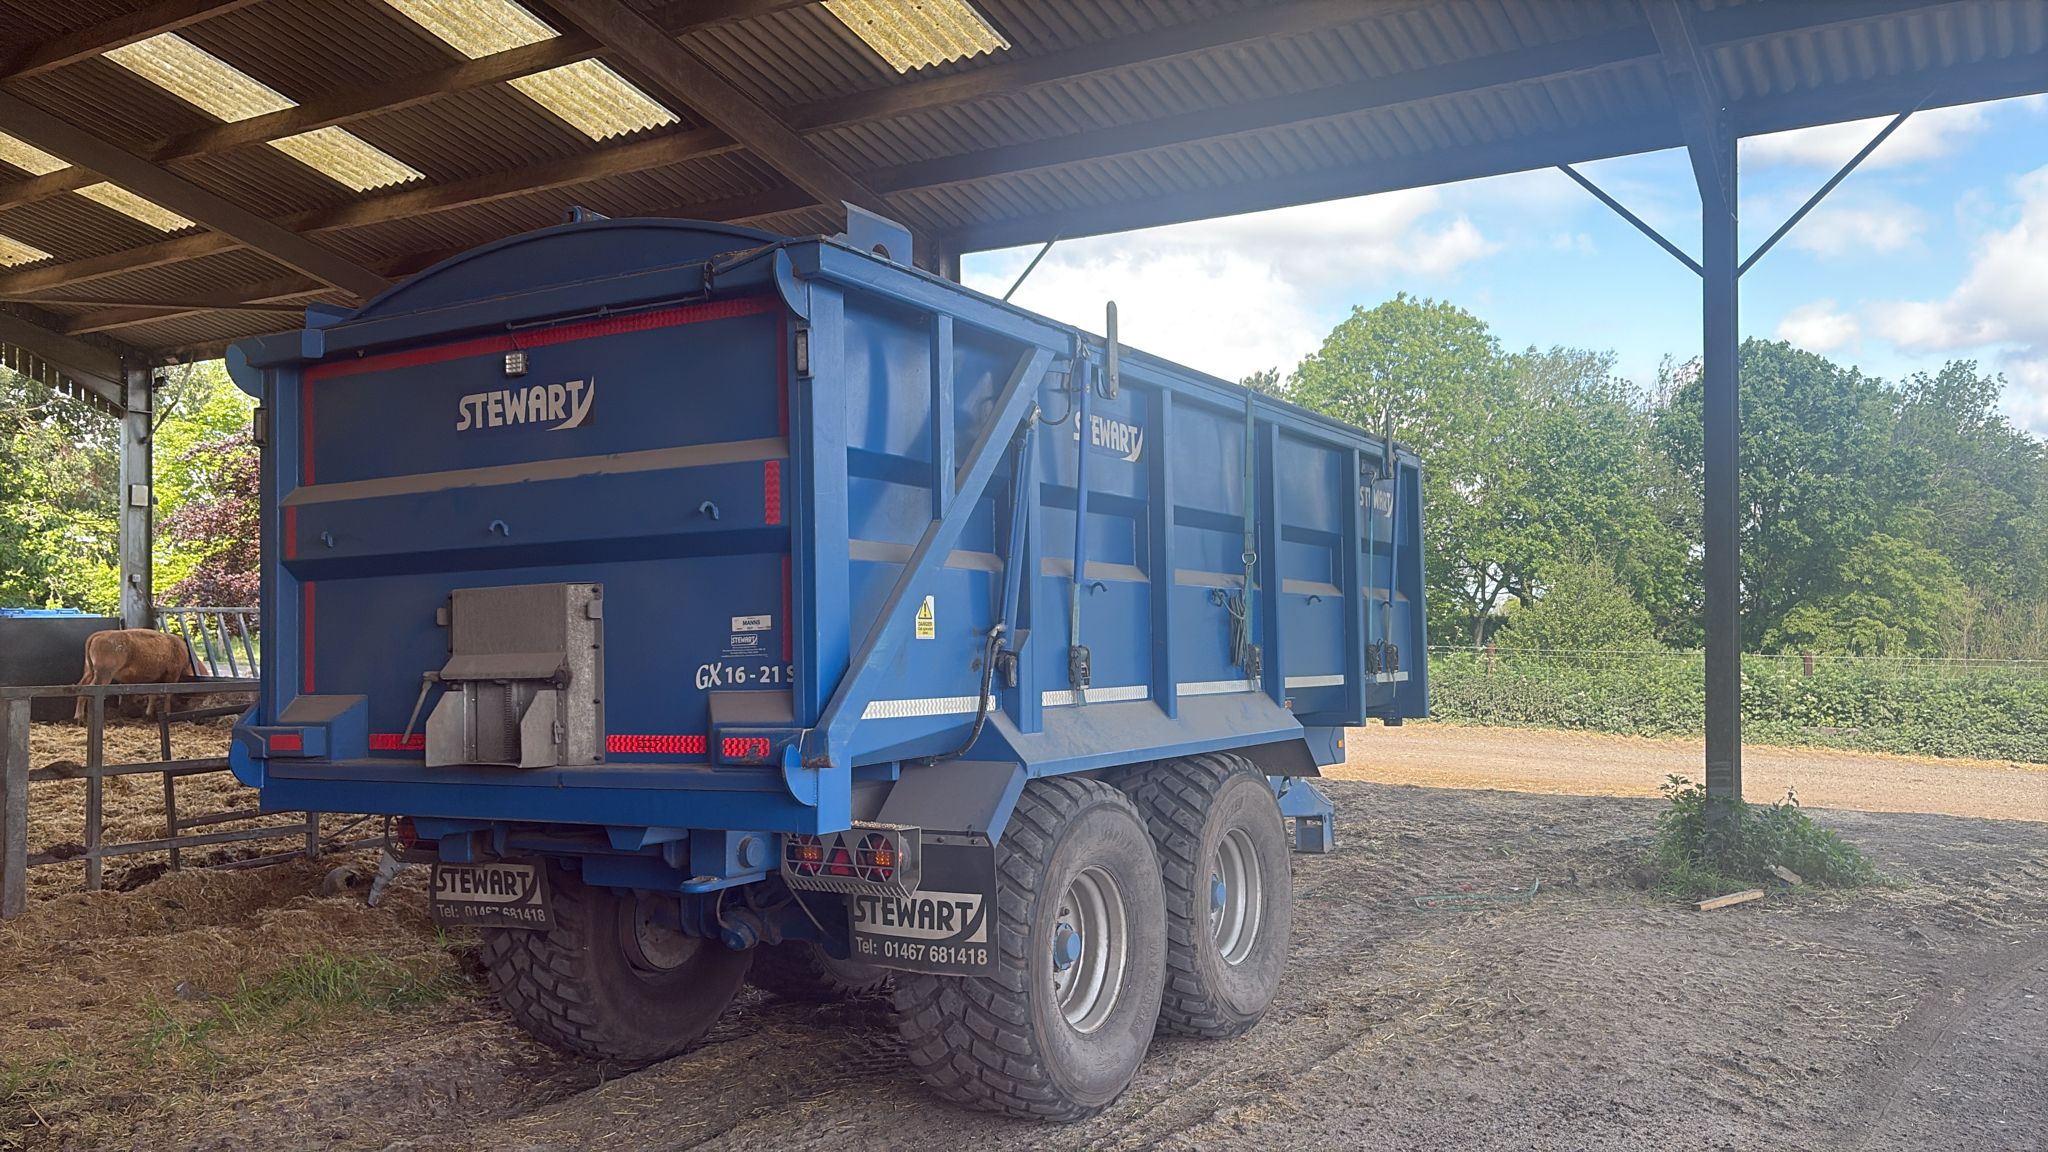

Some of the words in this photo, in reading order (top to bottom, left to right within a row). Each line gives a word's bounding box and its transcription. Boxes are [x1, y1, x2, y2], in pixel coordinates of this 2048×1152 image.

[456, 376, 595, 431] STEWART
[1073, 411, 1144, 463] SEWART
[1360, 486, 1394, 518] STWART
[731, 635, 758, 645] STEWART
[695, 662, 722, 690] GX
[725, 666, 746, 684] 16
[759, 665, 779, 683] 21
[436, 866, 540, 902] STEWART
[437, 904, 460, 918] Tel:
[854, 894, 986, 941] STEWART
[856, 936, 878, 955] Tel:
[884, 941, 926, 961] 01467
[929, 945, 988, 966] 681418
